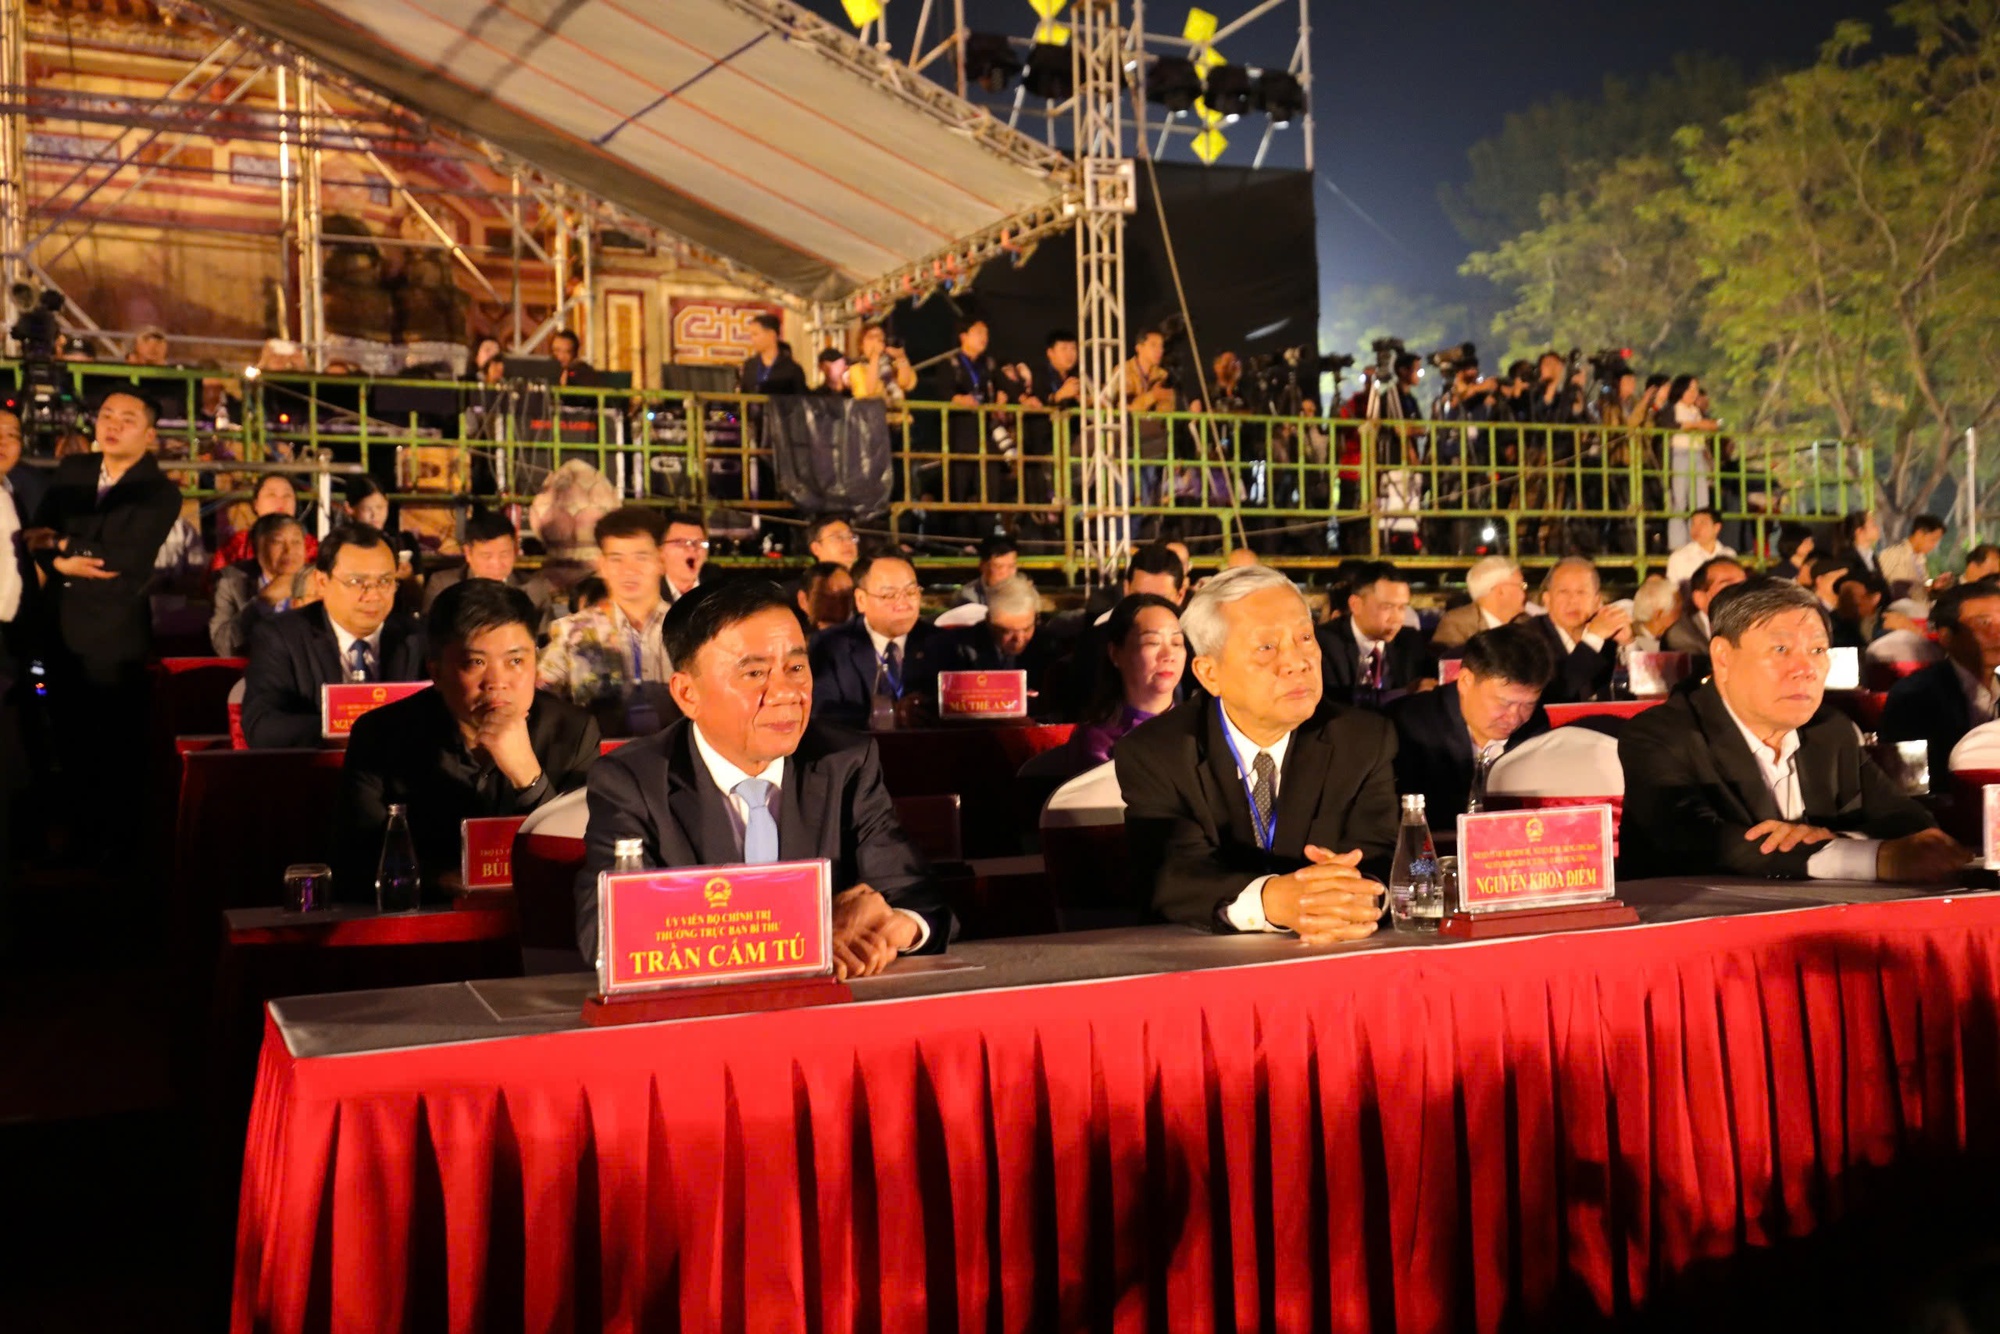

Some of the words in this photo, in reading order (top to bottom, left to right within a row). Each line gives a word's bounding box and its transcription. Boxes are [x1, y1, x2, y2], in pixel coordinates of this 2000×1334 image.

[681, 912, 704, 926] VIÊN
[629, 943, 701, 974] TRẦN
[772, 932, 806, 961] TÚ
